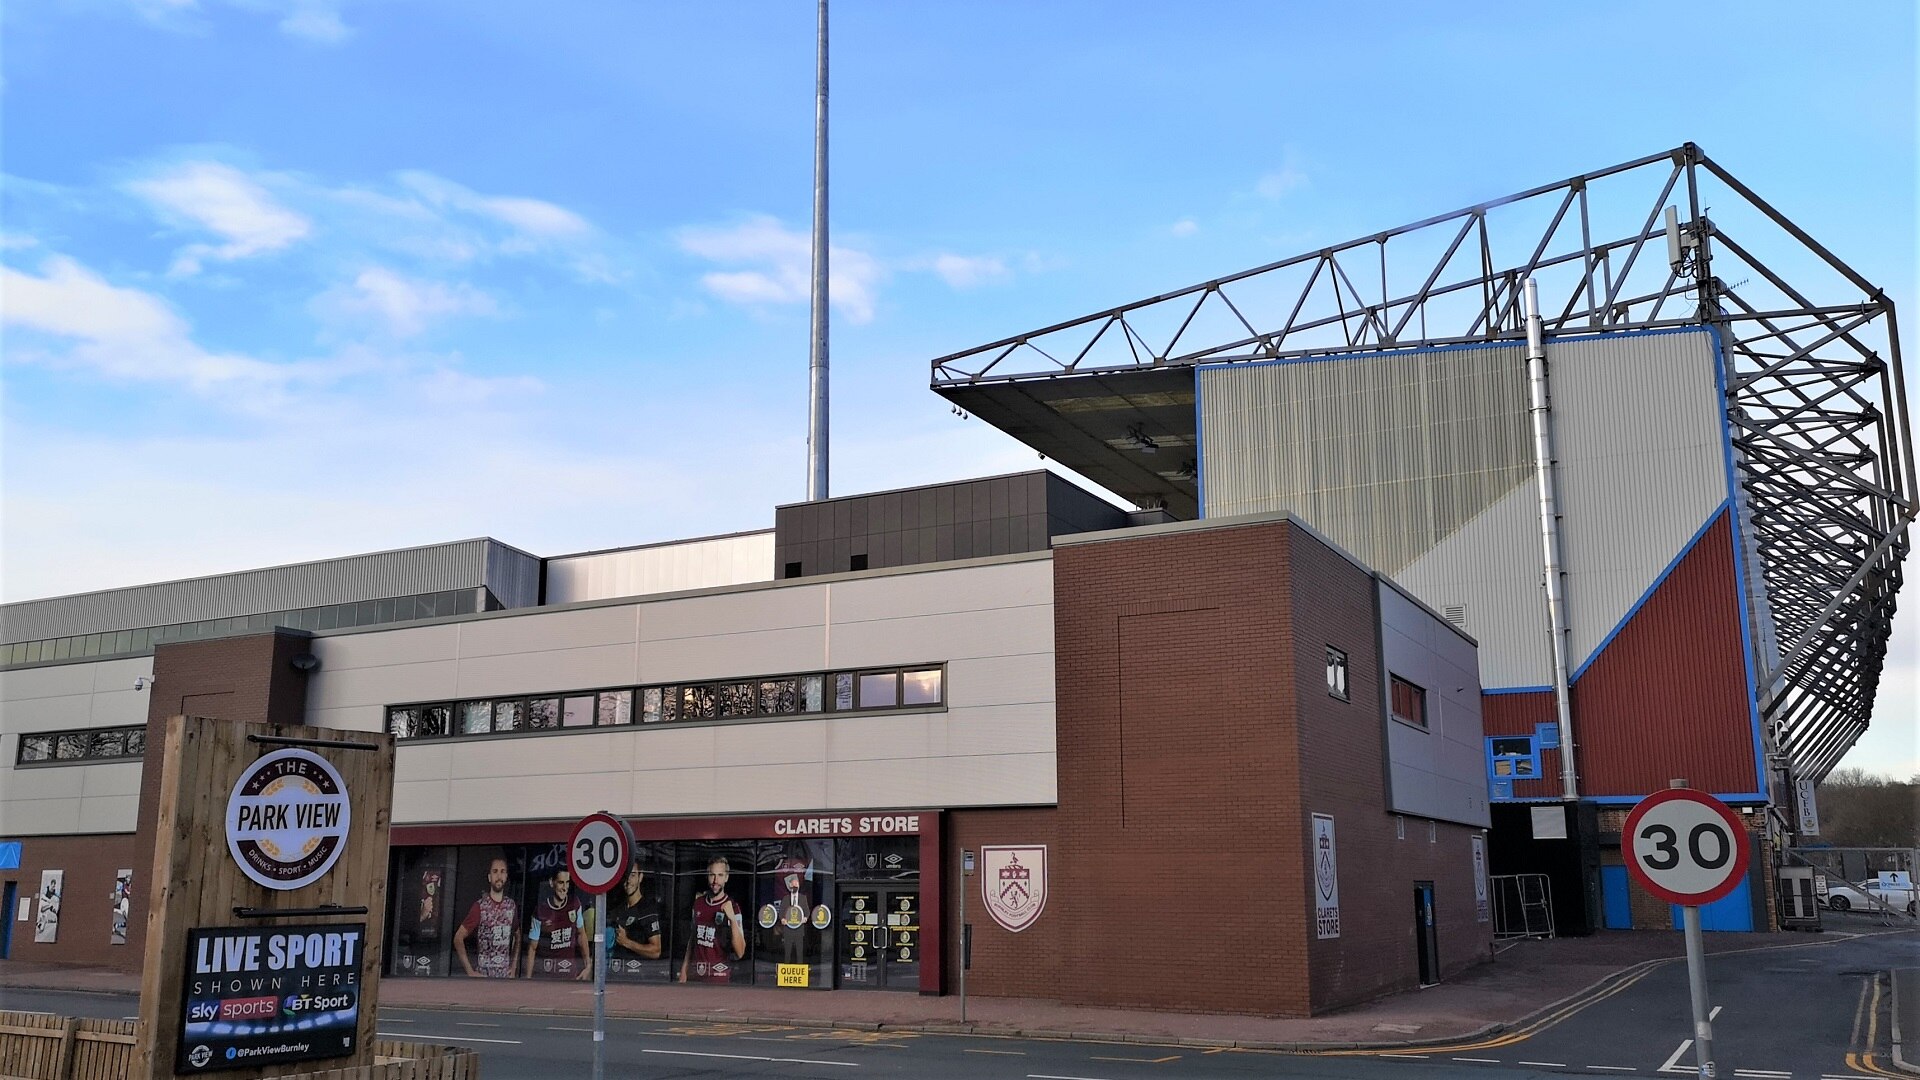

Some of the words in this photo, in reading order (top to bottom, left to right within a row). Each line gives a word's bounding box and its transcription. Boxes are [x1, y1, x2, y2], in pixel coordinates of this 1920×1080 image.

[275, 761, 307, 774] THE
[237, 804, 290, 831] PARK
[295, 802, 341, 829] VIEW
[774, 817, 852, 834] CLARETS
[859, 815, 919, 833] STORE
[576, 836, 619, 869] 30
[1640, 823, 1730, 870] 30
[248, 849, 272, 871] DRINKS
[278, 865, 301, 875] SPORT
[308, 846, 328, 867] MUSIC
[1317, 906, 1338, 919] CLARETS
[1318, 919, 1339, 936] STORE
[196, 935, 261, 974] LIVE
[267, 932, 358, 971] SPORT
[780, 967, 805, 976] QUEUE
[783, 976, 802, 984] HERE
[193, 977, 282, 995] SHOWN
[301, 972, 355, 988] HERE
[191, 1002, 219, 1021] sky
[223, 998, 275, 1018] sports
[291, 996, 312, 1011] BT
[313, 993, 348, 1011] Sport
[201, 1050, 214, 1059] VIEW
[237, 1042, 310, 1058] @ParkViewBurnley
